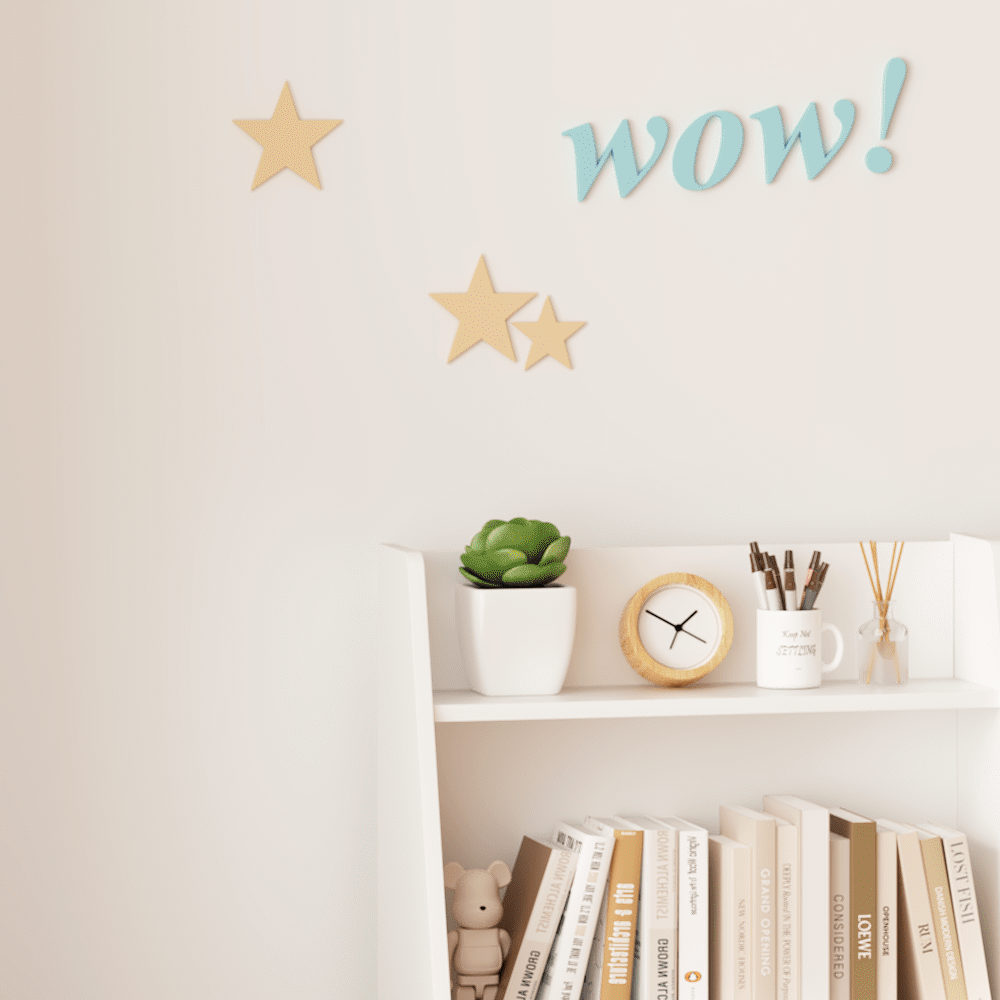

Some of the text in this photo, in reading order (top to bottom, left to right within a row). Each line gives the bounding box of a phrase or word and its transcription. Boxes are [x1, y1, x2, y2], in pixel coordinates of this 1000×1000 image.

[562, 57, 907, 202] wow!
[760, 868, 771, 976] GRAND OPENING
[950, 841, 975, 924] LOST FISH
[833, 894, 844, 980] CONSIDERED
[857, 914, 871, 960] LOEWE
[918, 923, 933, 954] RUM
